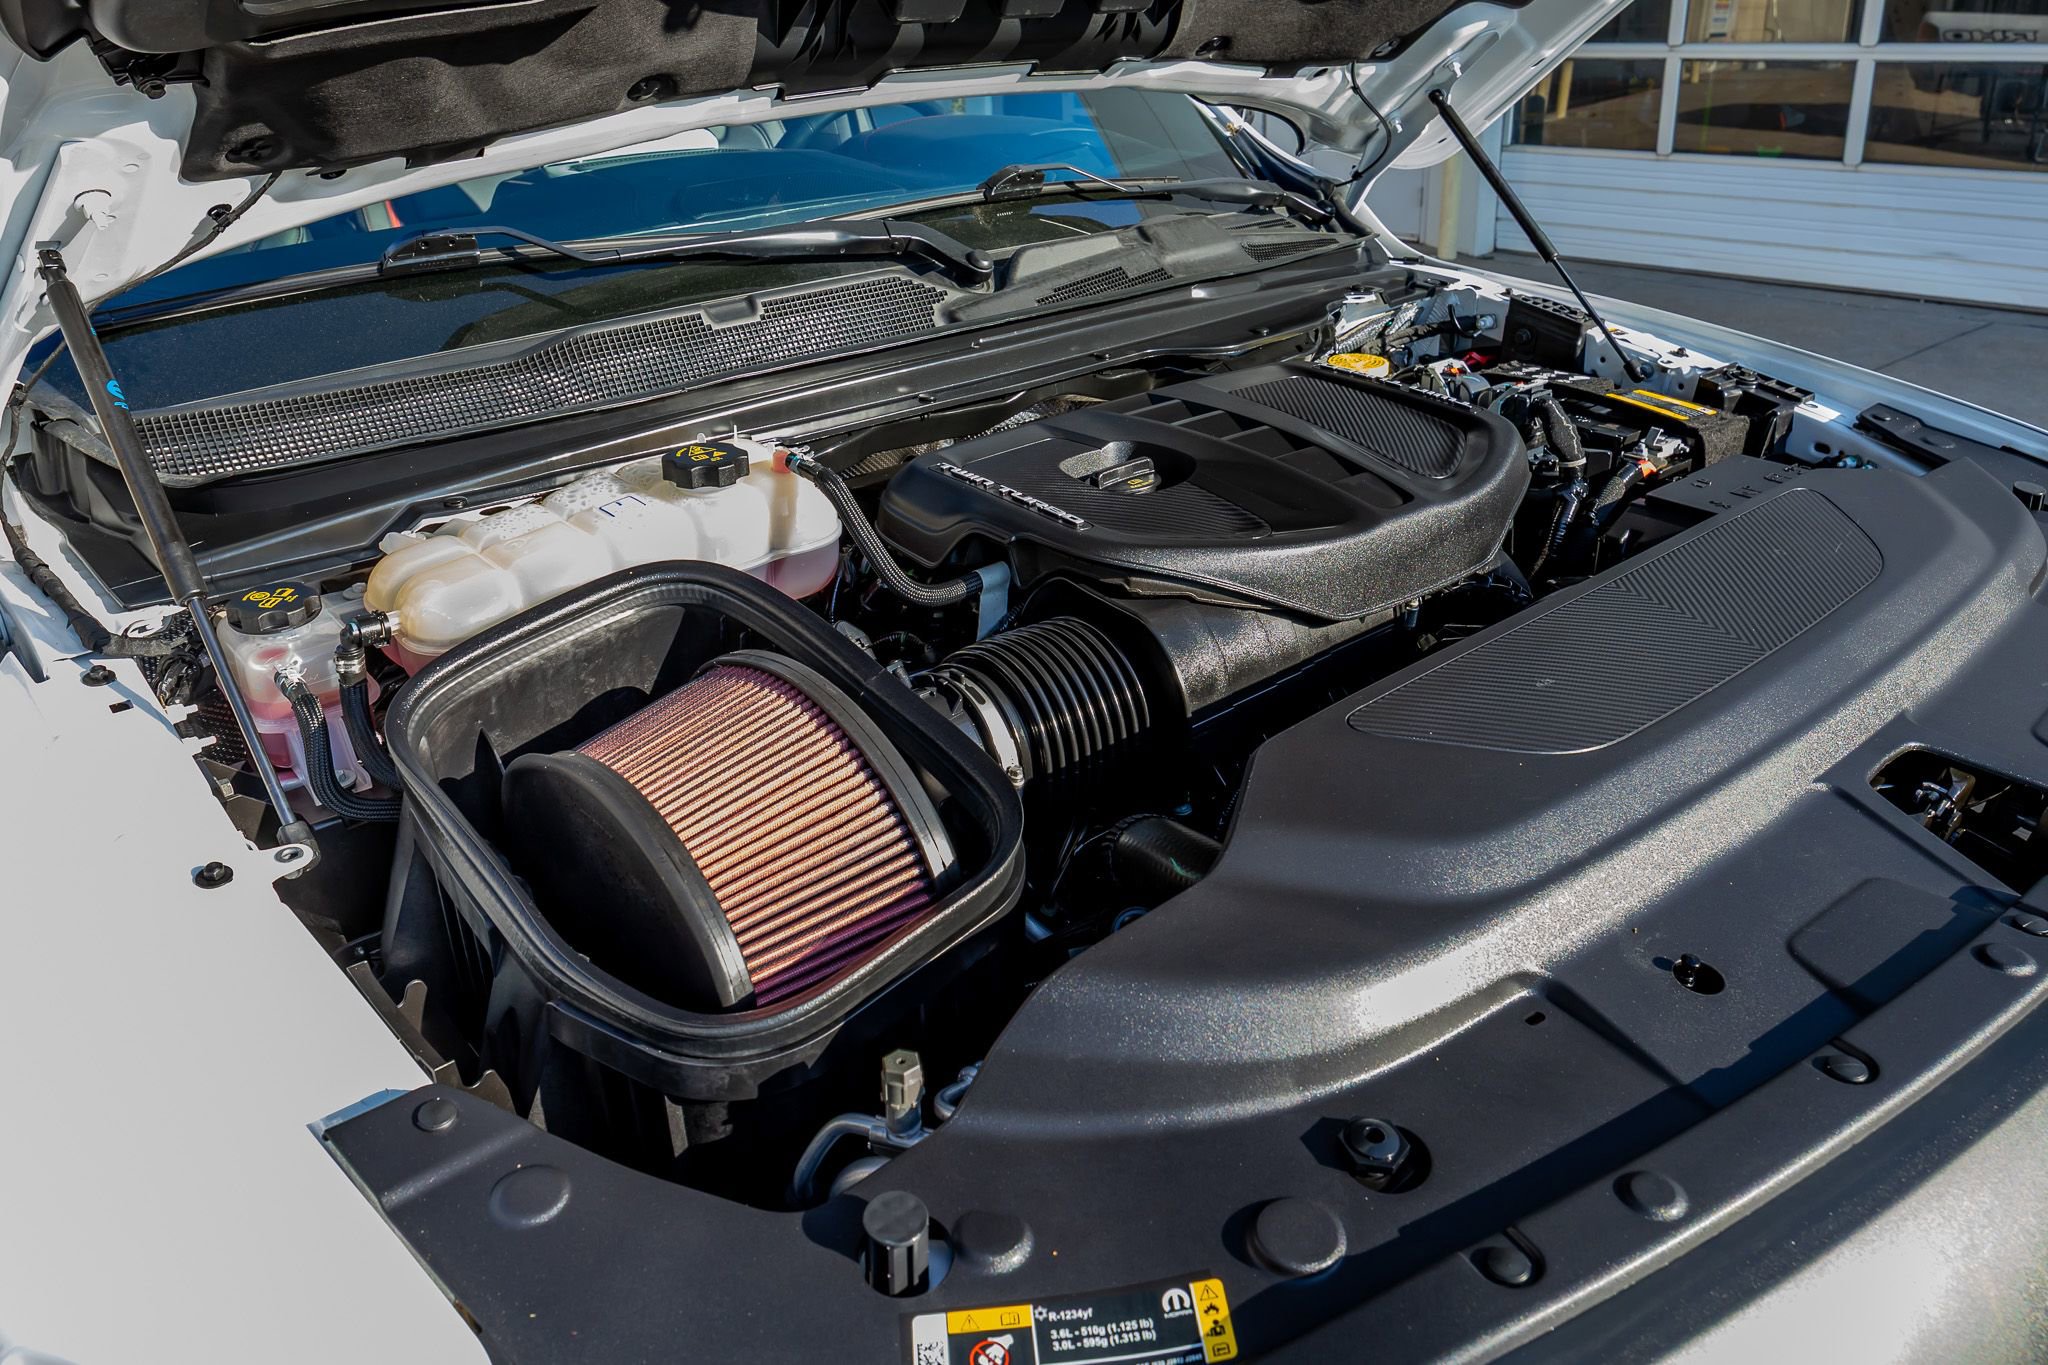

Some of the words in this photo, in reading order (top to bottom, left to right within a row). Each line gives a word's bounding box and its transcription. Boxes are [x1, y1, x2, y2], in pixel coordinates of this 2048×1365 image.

[936, 462, 994, 489] TWIN
[999, 484, 1085, 529] TURBO
[1048, 1307, 1093, 1322] R-1234yf
[1050, 1328, 1073, 1340] 3.6L
[1080, 1325, 1106, 1337] 510g
[1107, 1319, 1138, 1334] (1.125
[1138, 1317, 1154, 1329] lb)
[1052, 1340, 1075, 1351] 3.0L
[1083, 1336, 1108, 1348] 595g
[1109, 1331, 1141, 1347] (1.313
[1141, 1329, 1157, 1341] lb)
